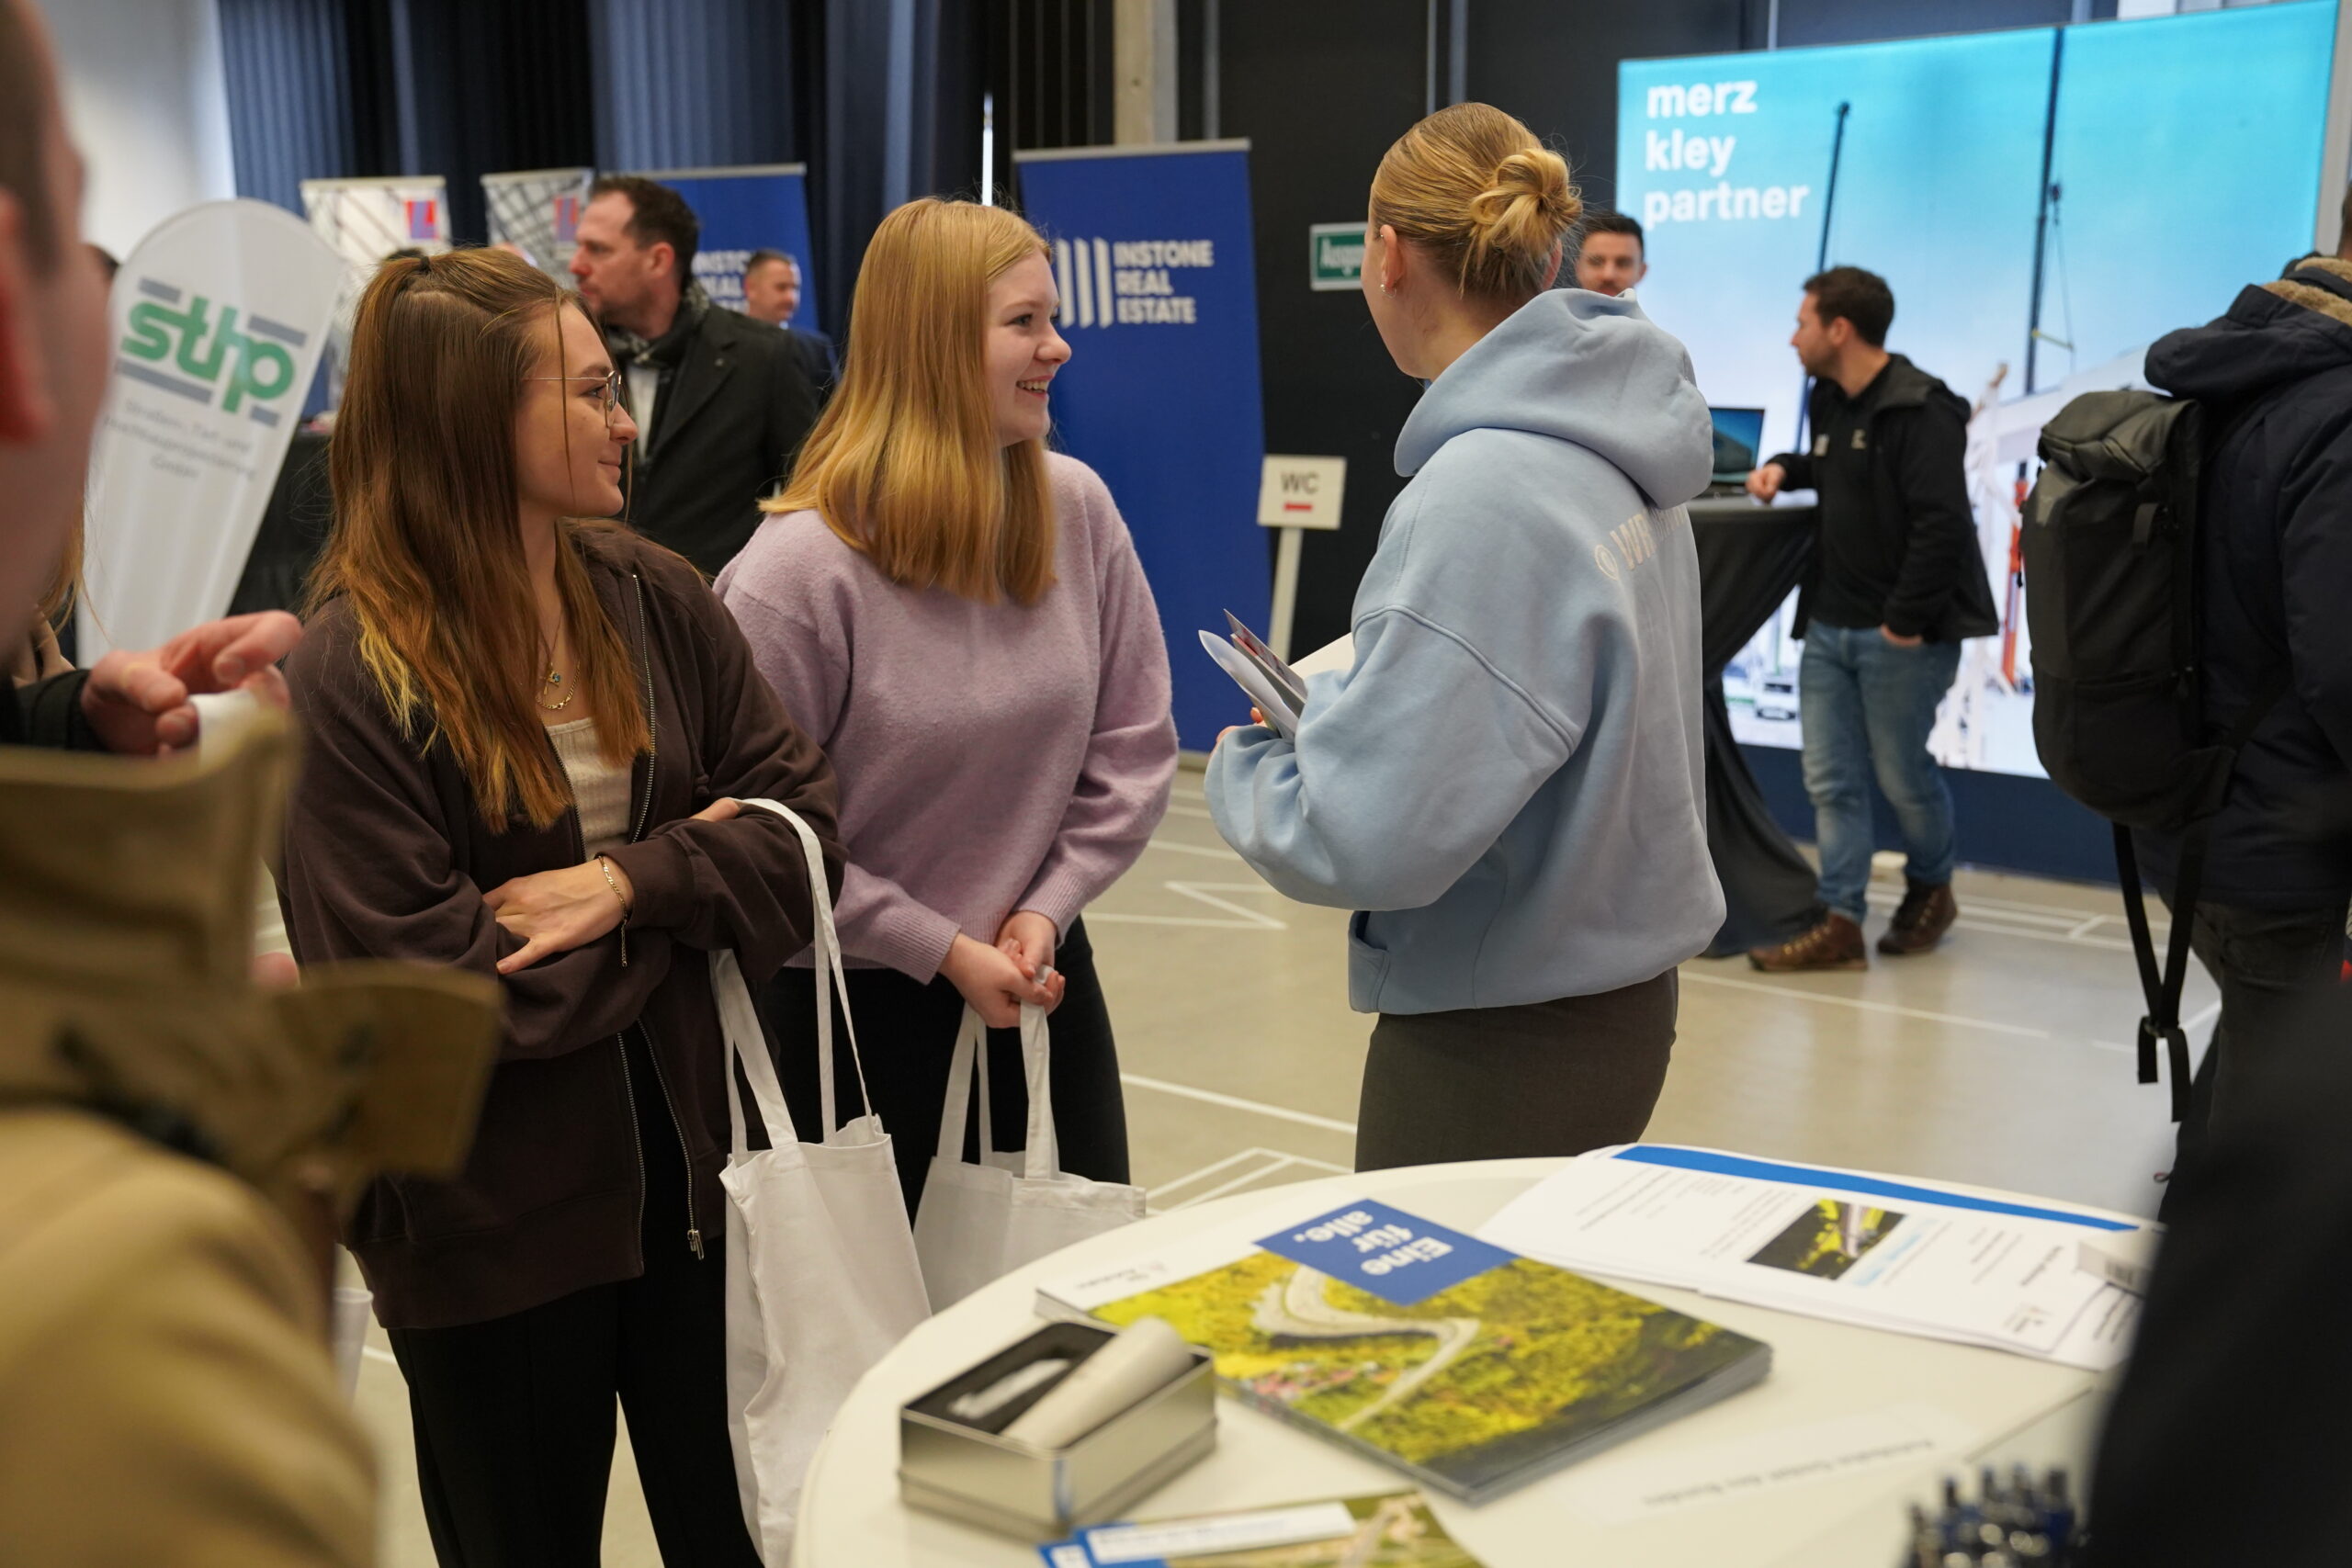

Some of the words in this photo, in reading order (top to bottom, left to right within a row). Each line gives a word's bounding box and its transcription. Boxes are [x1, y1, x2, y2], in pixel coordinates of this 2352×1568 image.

[1647, 80, 1758, 118] merz
[1645, 128, 1736, 177] kley
[1643, 181, 1810, 231] partner
[1114, 240, 1213, 267] INSTONE
[1115, 268, 1173, 295] REAL
[1116, 296, 1197, 323] ESTATE
[1280, 470, 1319, 494] WC
[1293, 1210, 1374, 1242] alle.
[1351, 1224, 1413, 1253] für
[1361, 1236, 1453, 1275] Eine
